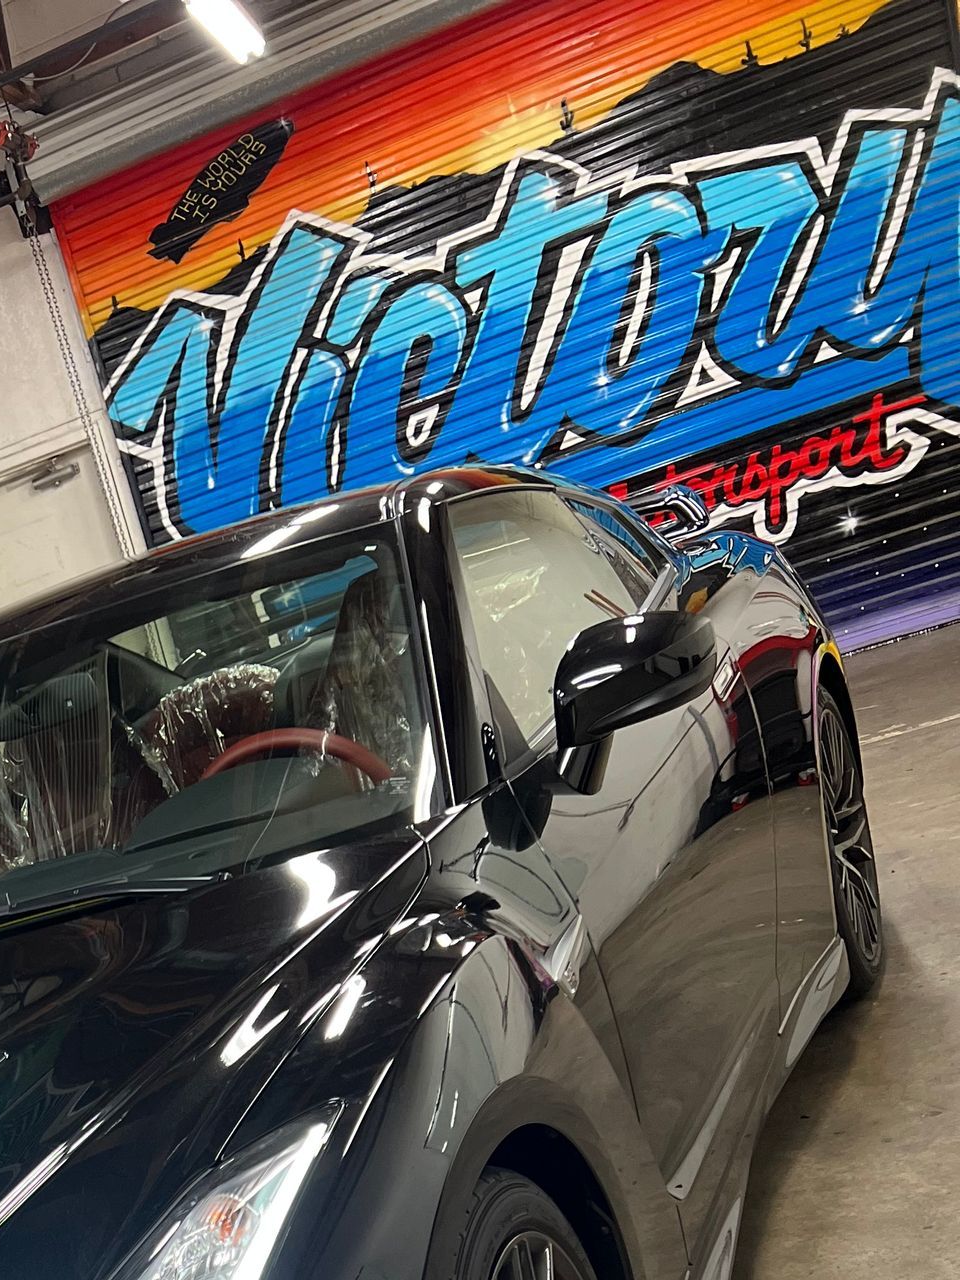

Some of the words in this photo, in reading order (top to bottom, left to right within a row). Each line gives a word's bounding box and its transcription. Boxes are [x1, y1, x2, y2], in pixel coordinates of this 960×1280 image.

[170, 190, 202, 221] THE
[196, 133, 255, 189] WORLD
[192, 194, 218, 224] IS
[211, 140, 267, 192] YOURS
